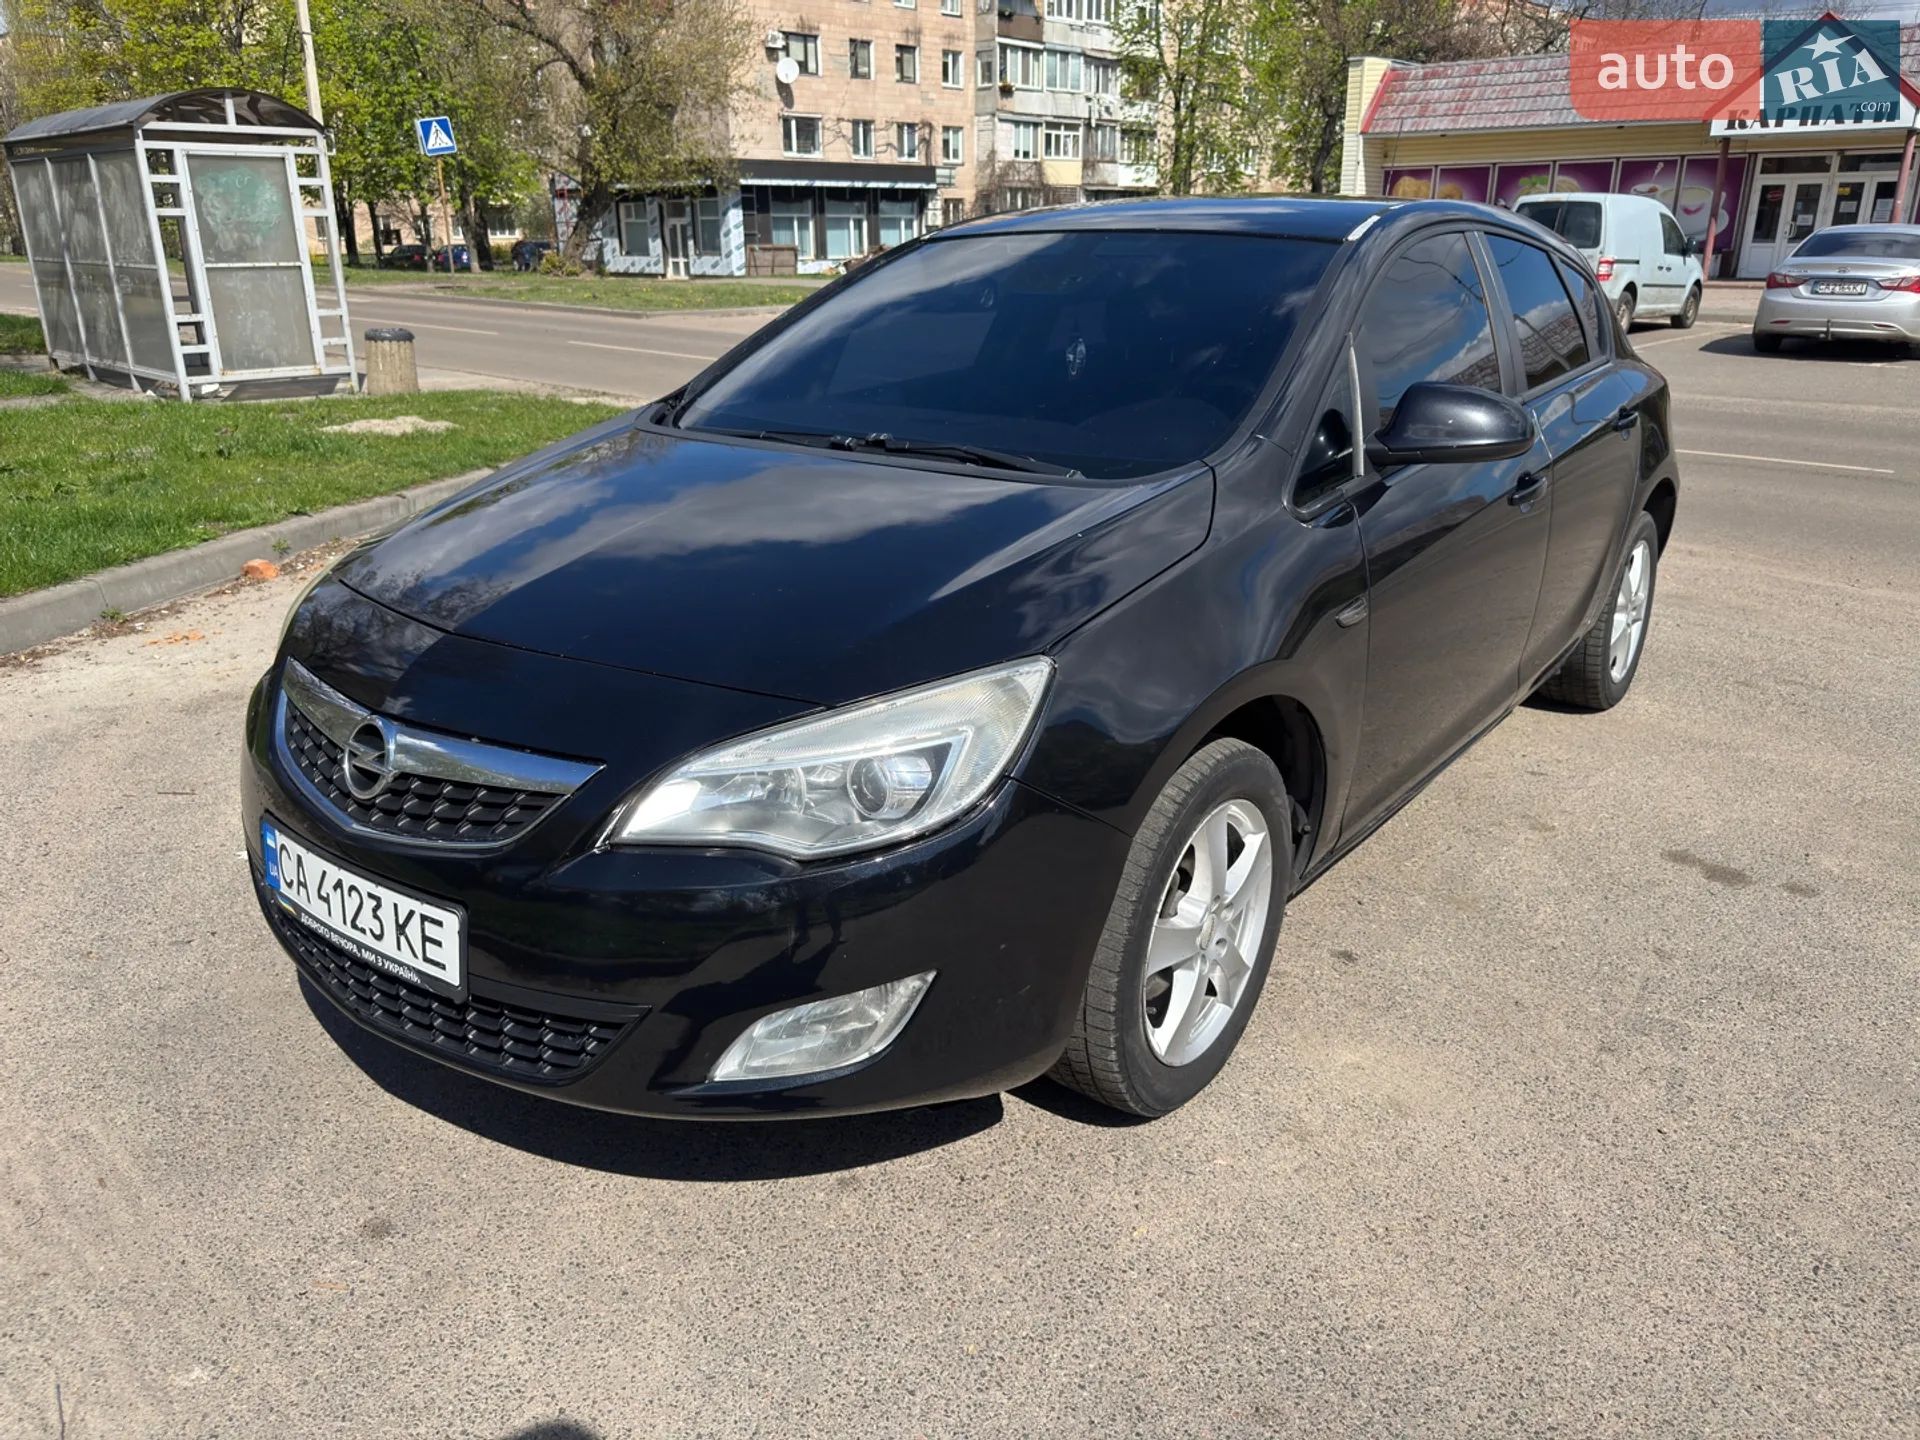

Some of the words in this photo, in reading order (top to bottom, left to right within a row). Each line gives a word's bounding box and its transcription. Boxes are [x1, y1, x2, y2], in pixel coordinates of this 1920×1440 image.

[1724, 101, 1899, 131] КАРПАТИ
[269, 860, 279, 877] UA
[279, 842, 312, 904] CA
[317, 869, 385, 942] 4123
[393, 902, 447, 971] KE
[361, 948, 376, 964] МИ
